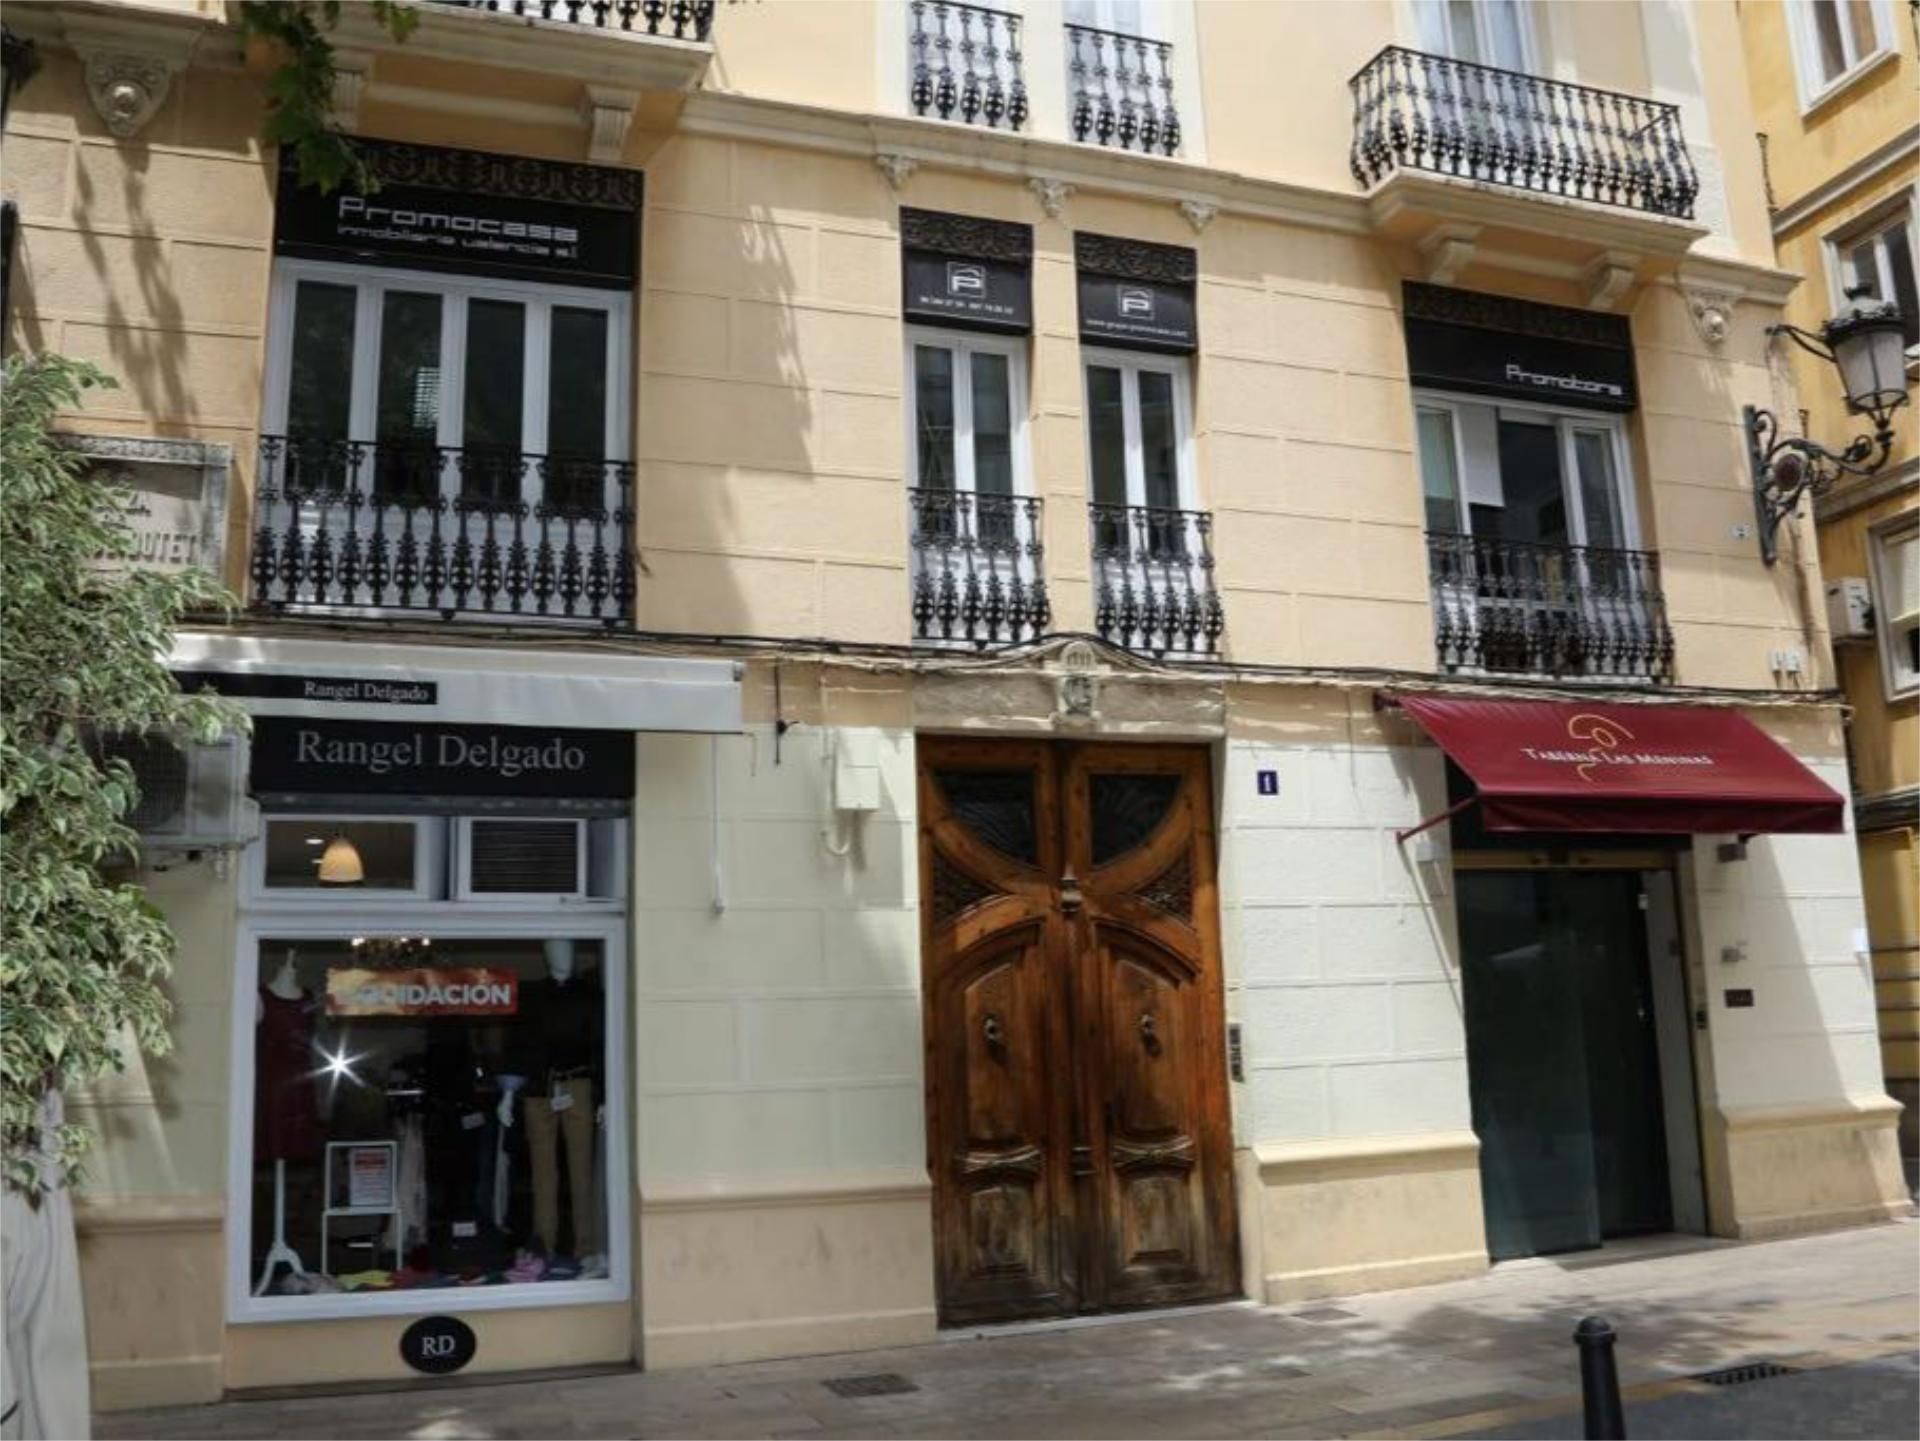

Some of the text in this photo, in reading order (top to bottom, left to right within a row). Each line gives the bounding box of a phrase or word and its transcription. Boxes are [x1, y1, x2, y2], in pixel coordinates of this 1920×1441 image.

[338, 196, 579, 242] Promocasa
[1505, 363, 1623, 396] Promotora
[303, 681, 430, 703] Rangel Delgado
[296, 730, 586, 777] Rangel Delgado
[335, 977, 512, 1006] QUIDACIÓN
[421, 1334, 456, 1356] RD
